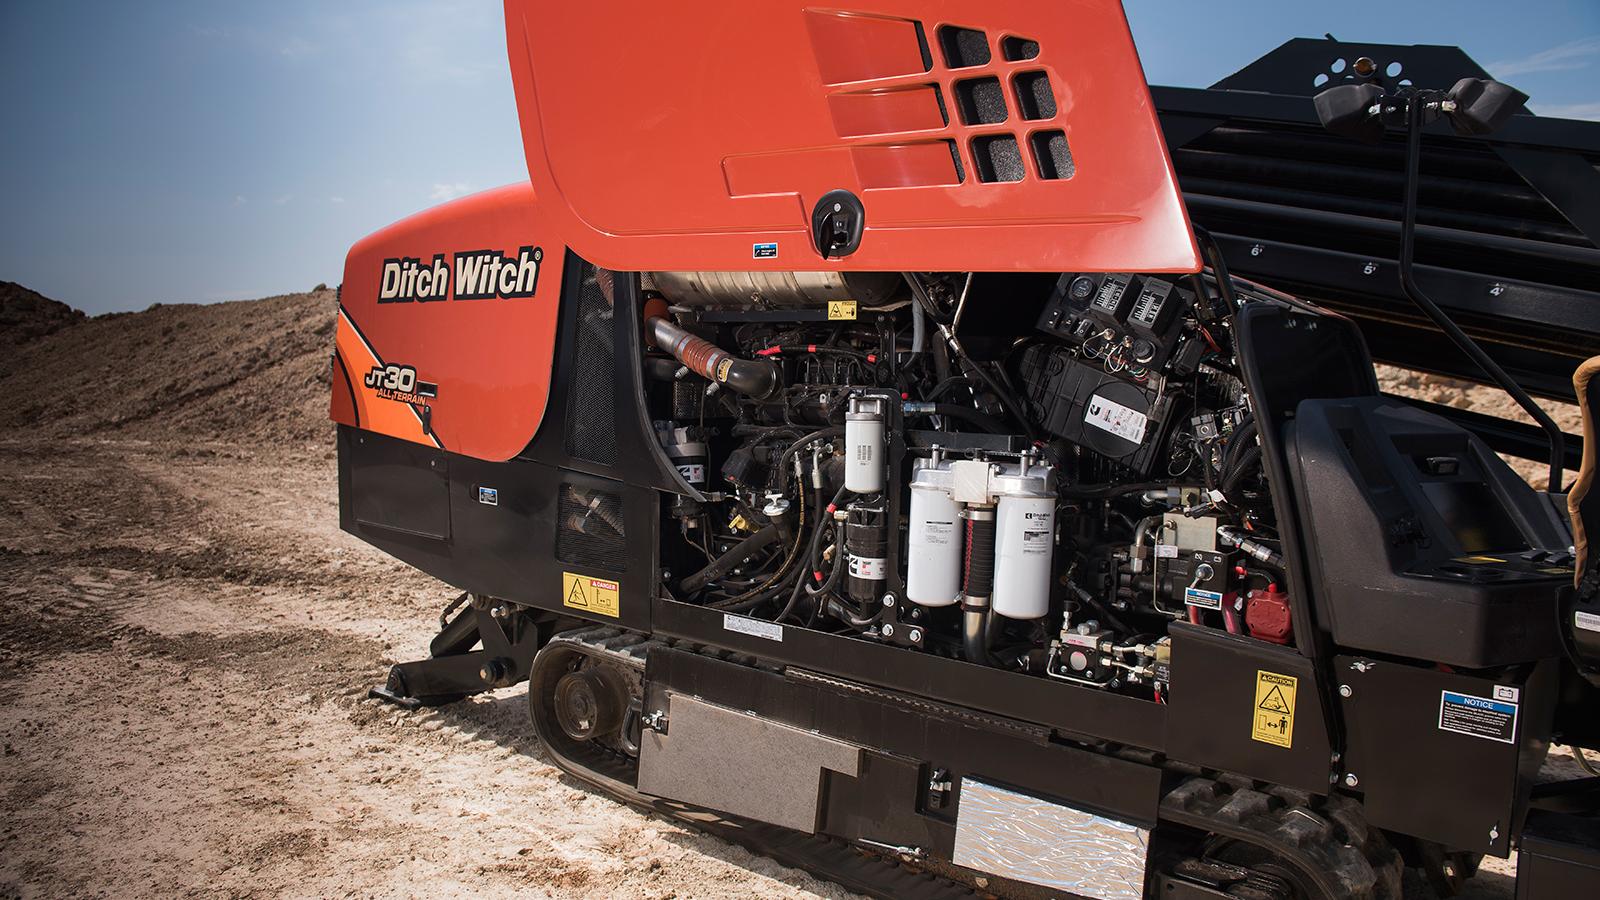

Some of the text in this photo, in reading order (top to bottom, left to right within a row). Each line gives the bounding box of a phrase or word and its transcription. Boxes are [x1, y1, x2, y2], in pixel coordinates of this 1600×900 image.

[380, 258, 449, 299] Ditch
[365, 365, 416, 393] JT30
[377, 388, 426, 406] ALL TERRAIN
[1267, 675, 1294, 687] CAUTION
[1463, 697, 1494, 709] NOTICE
